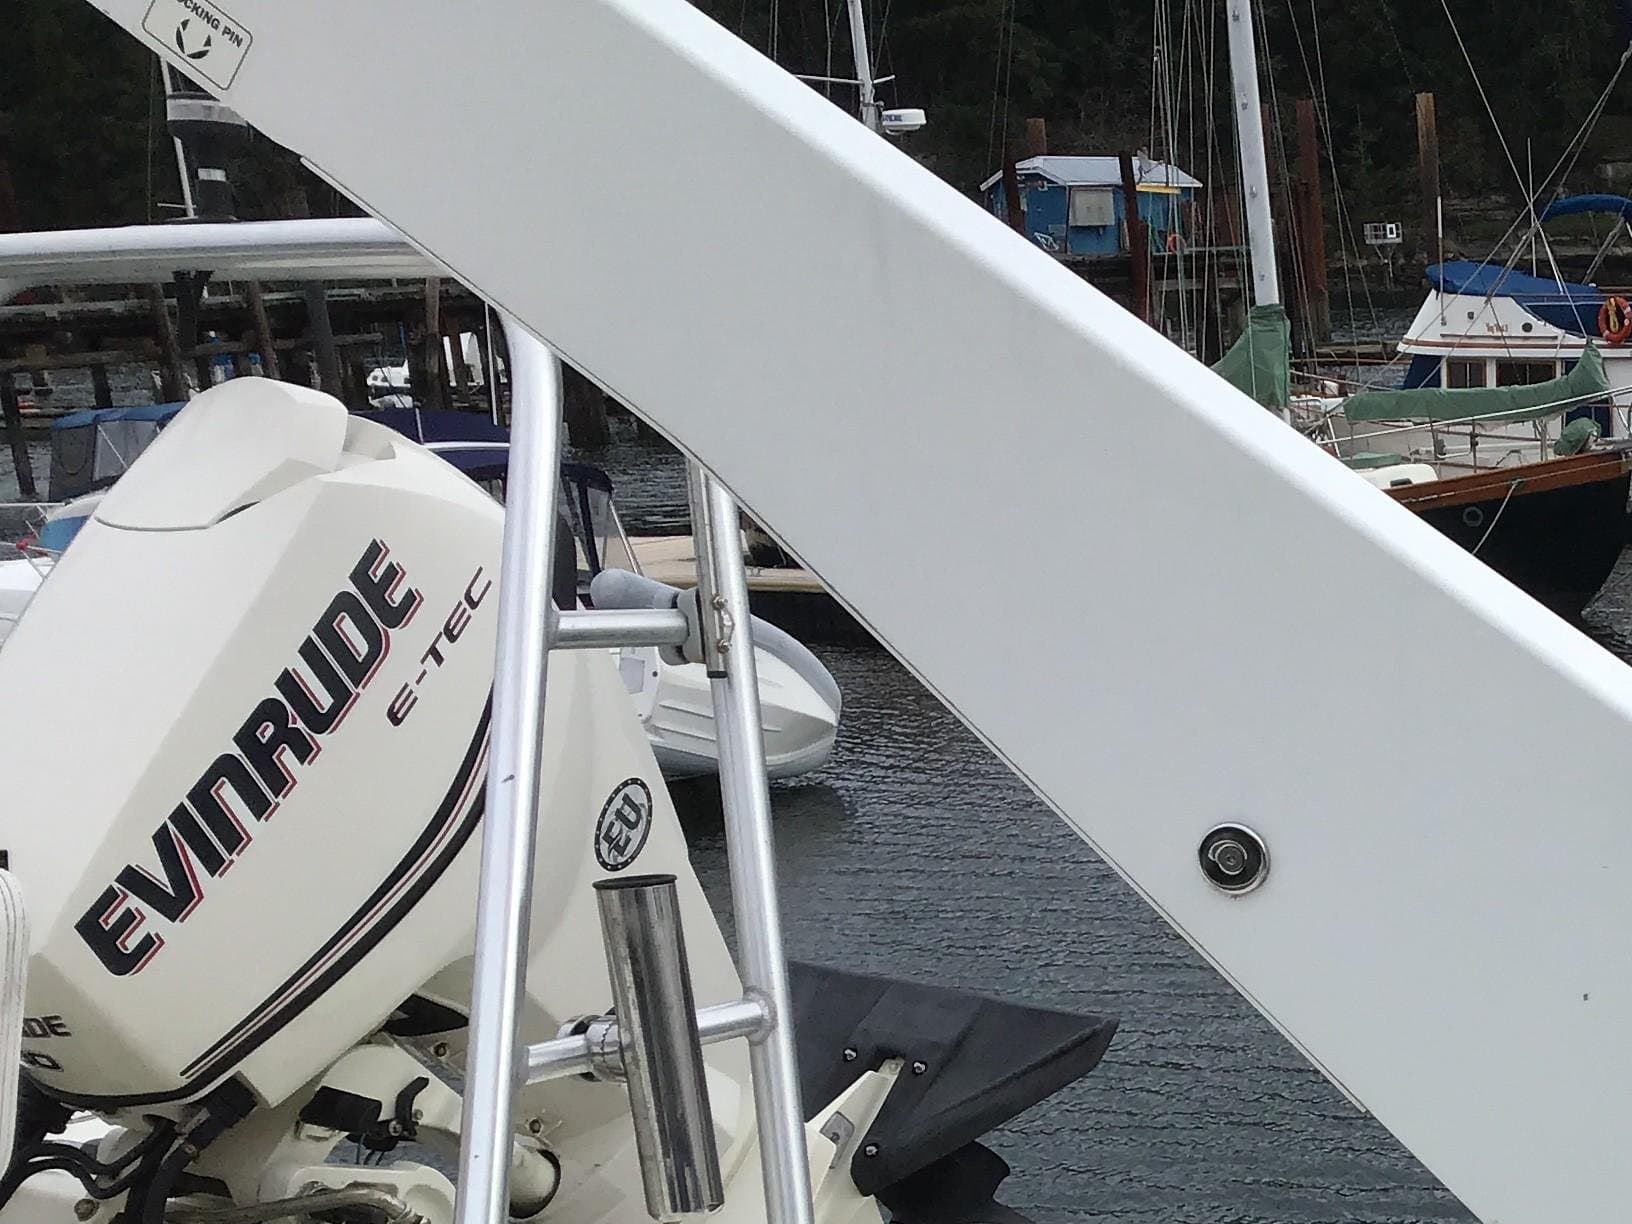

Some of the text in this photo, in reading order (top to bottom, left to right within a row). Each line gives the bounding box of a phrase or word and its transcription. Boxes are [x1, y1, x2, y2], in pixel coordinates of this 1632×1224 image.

[177, 0, 243, 48] CKING PIN
[386, 565, 493, 727] E-TEC
[74, 538, 424, 977] EVINRUDE
